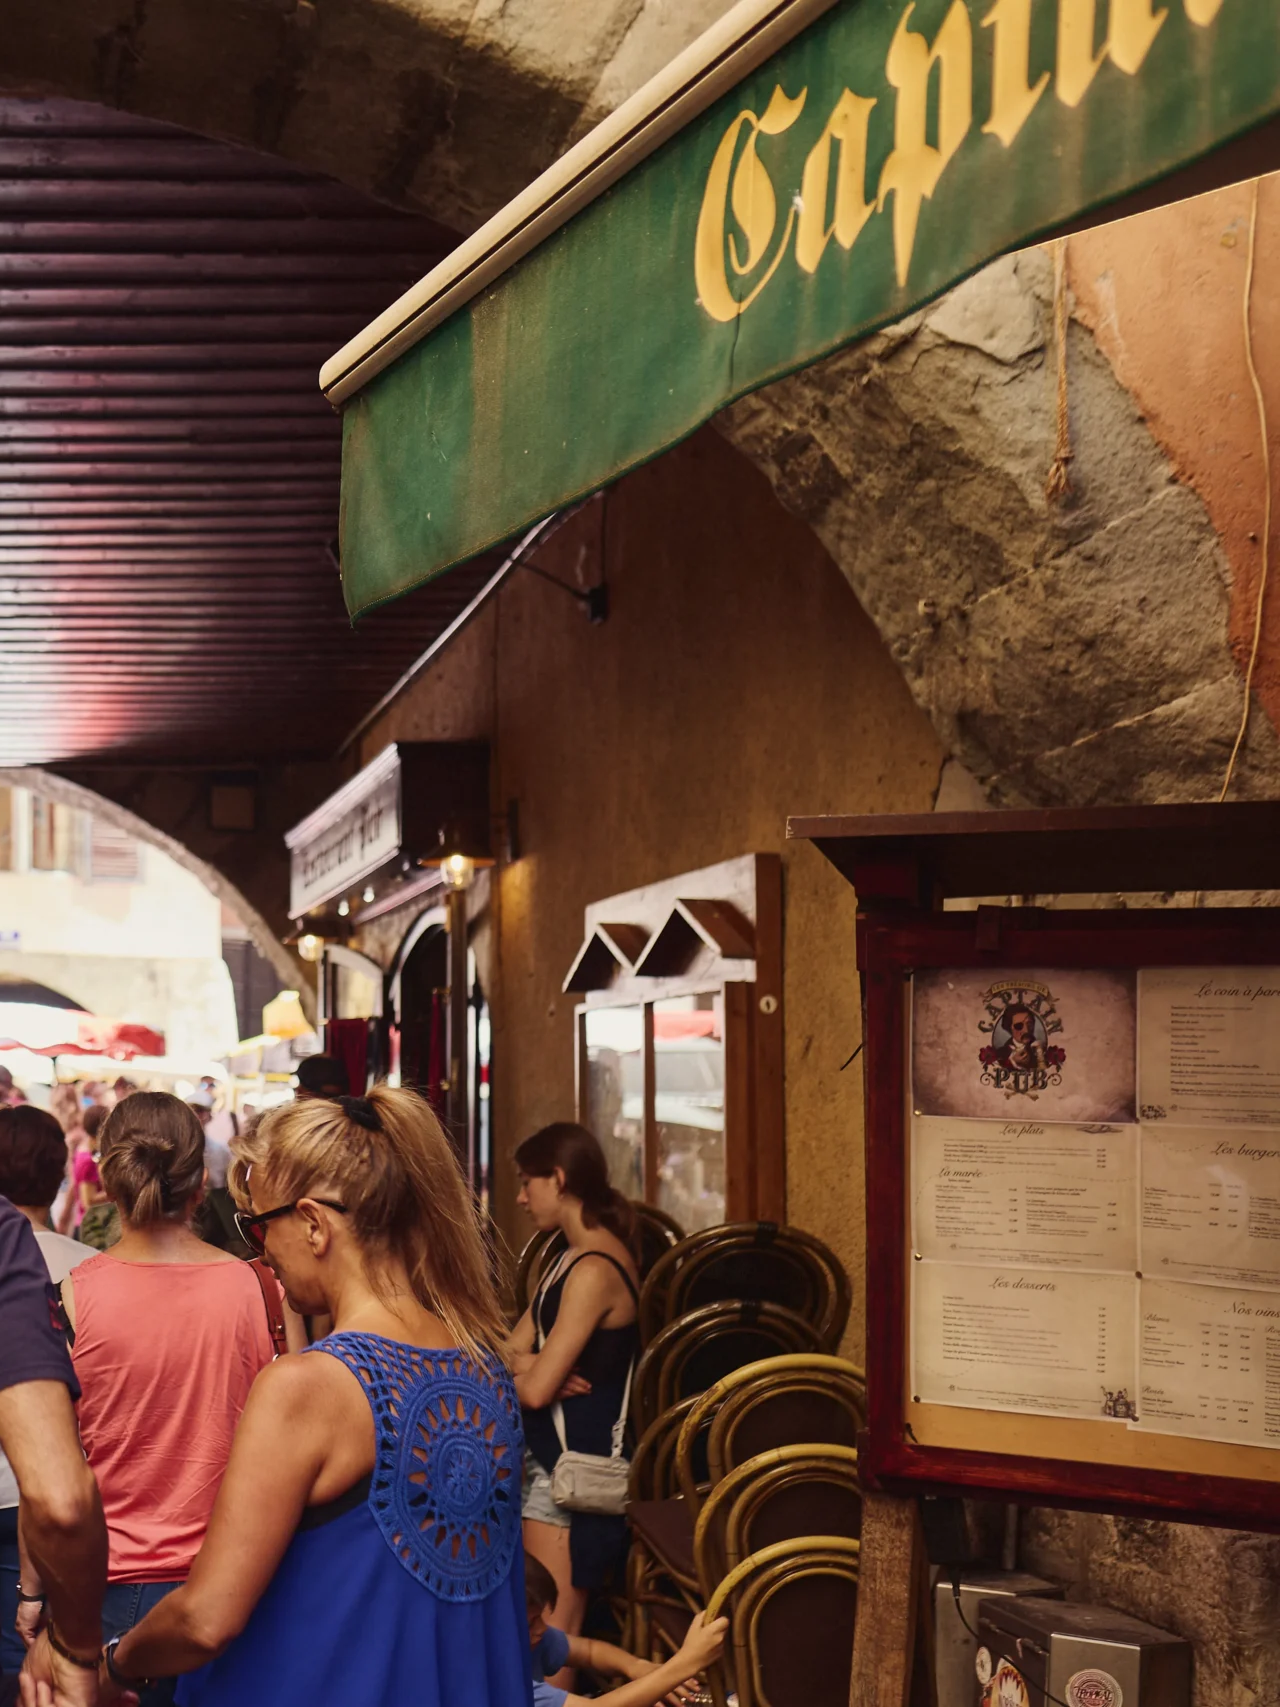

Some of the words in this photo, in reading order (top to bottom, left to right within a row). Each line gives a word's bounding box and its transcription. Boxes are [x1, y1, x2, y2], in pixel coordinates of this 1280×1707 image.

[1214, 986, 1239, 996] coin
[978, 990, 1064, 1034] CAPTAIN
[993, 1067, 1048, 1093] PUB
[999, 1123, 1017, 1136] Les
[1016, 1124, 1045, 1138] plats
[1210, 1141, 1234, 1155] Les
[939, 1166, 951, 1178] La
[988, 1276, 1009, 1289] Les
[1012, 1277, 1056, 1291] desserts
[1224, 1301, 1253, 1315] Nos
